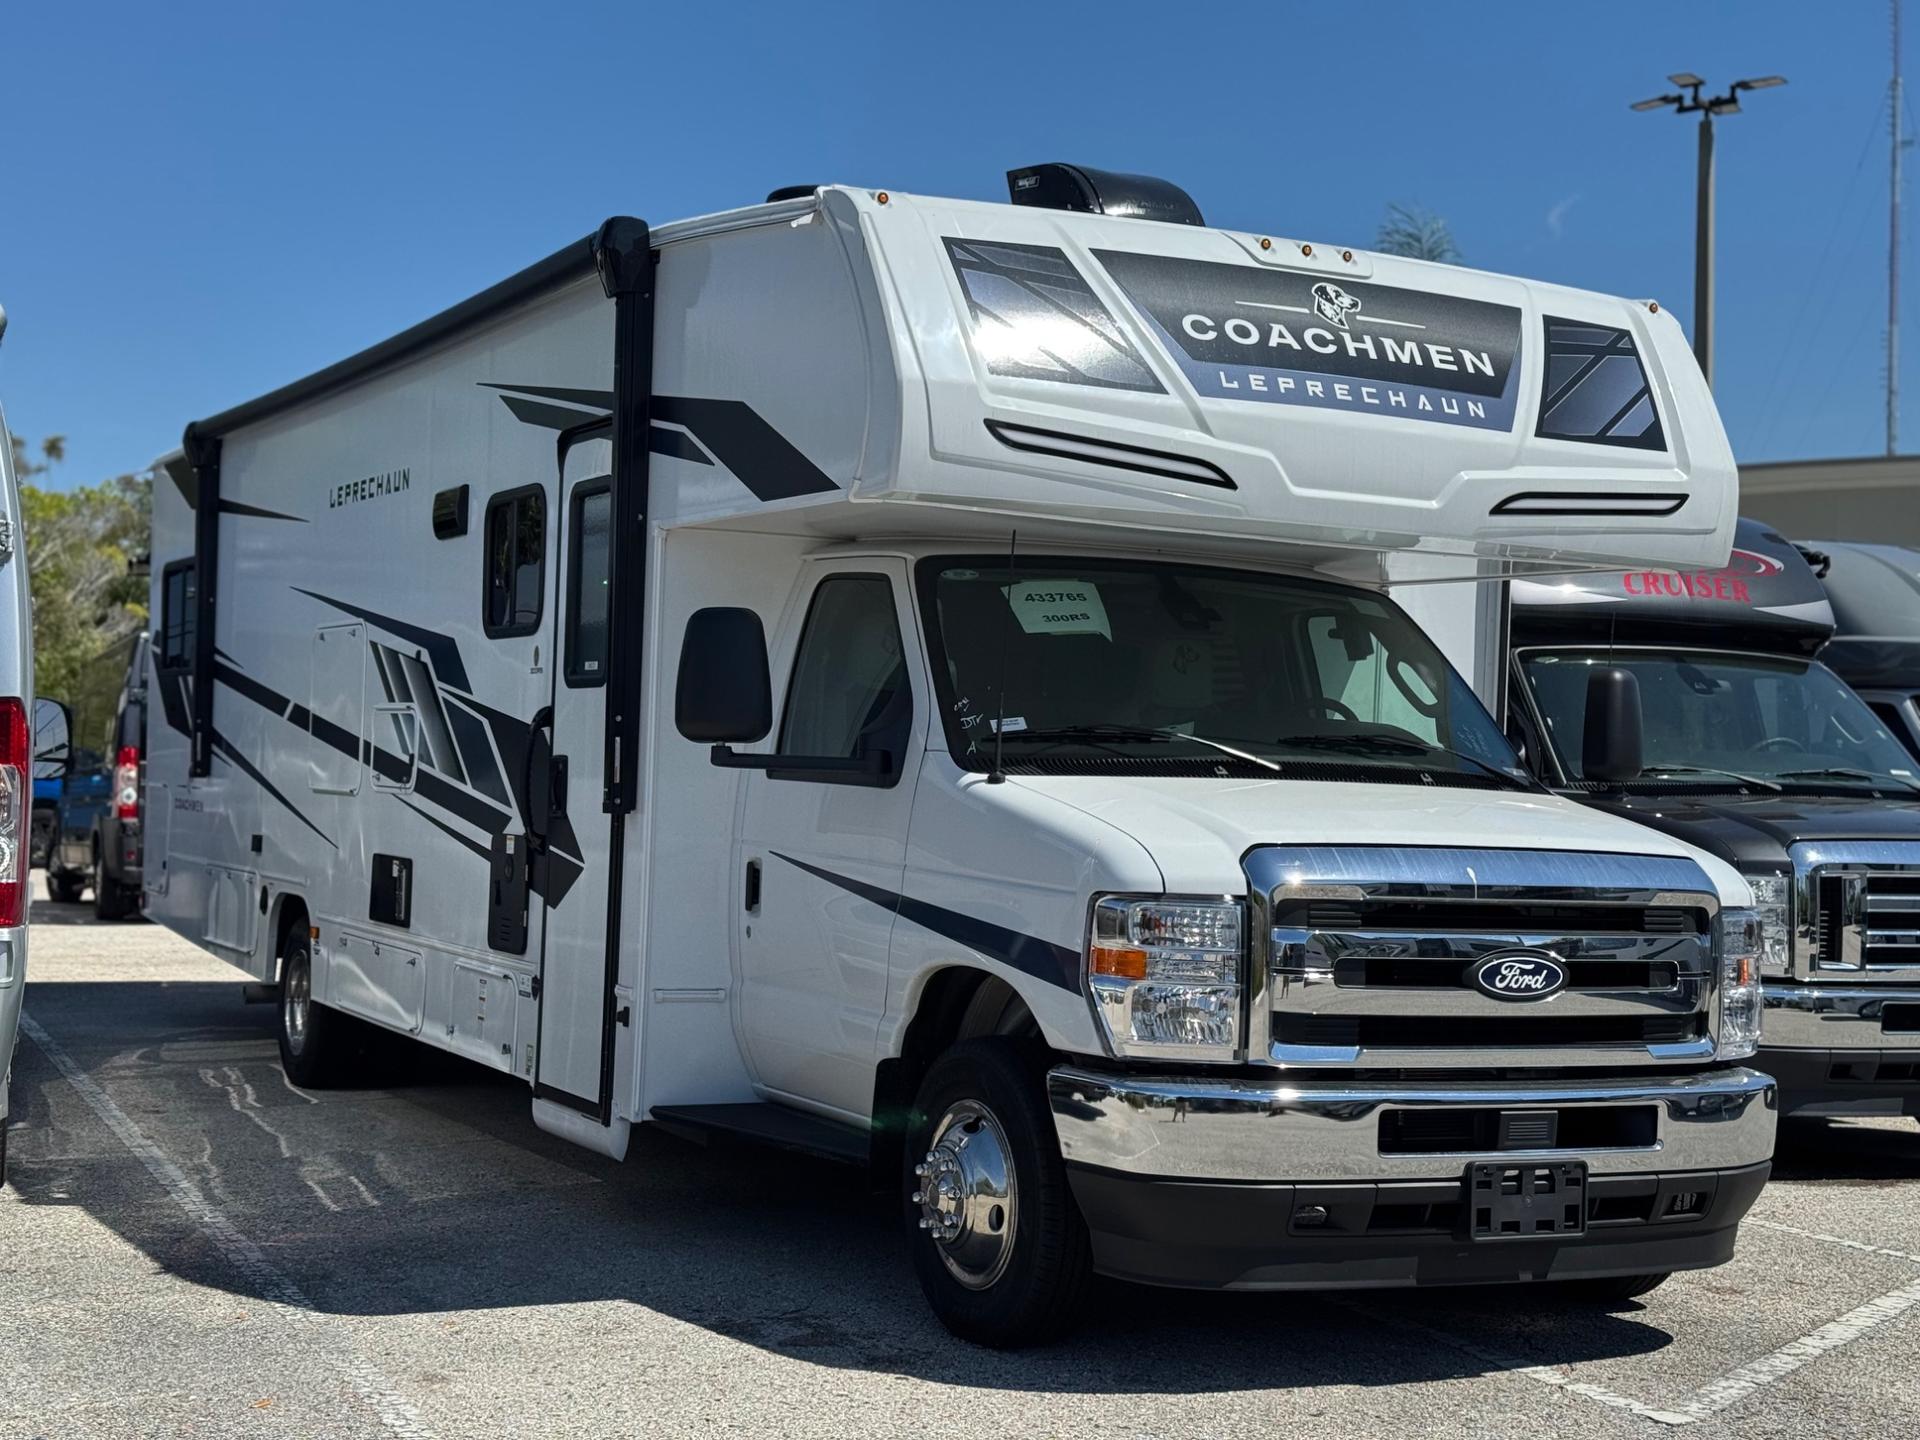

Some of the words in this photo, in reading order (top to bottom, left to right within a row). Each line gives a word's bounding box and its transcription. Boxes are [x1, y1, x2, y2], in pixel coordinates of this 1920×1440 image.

[1181, 313, 1496, 377] COACHMEN
[1218, 370, 1486, 419] LEPRECHAUN
[329, 467, 410, 509] LEPRECHAUN
[1024, 592, 1087, 603] 433765
[1623, 571, 1752, 603] CRUISER
[1042, 612, 1091, 623] 300RS
[1495, 962, 1548, 989] Ford
